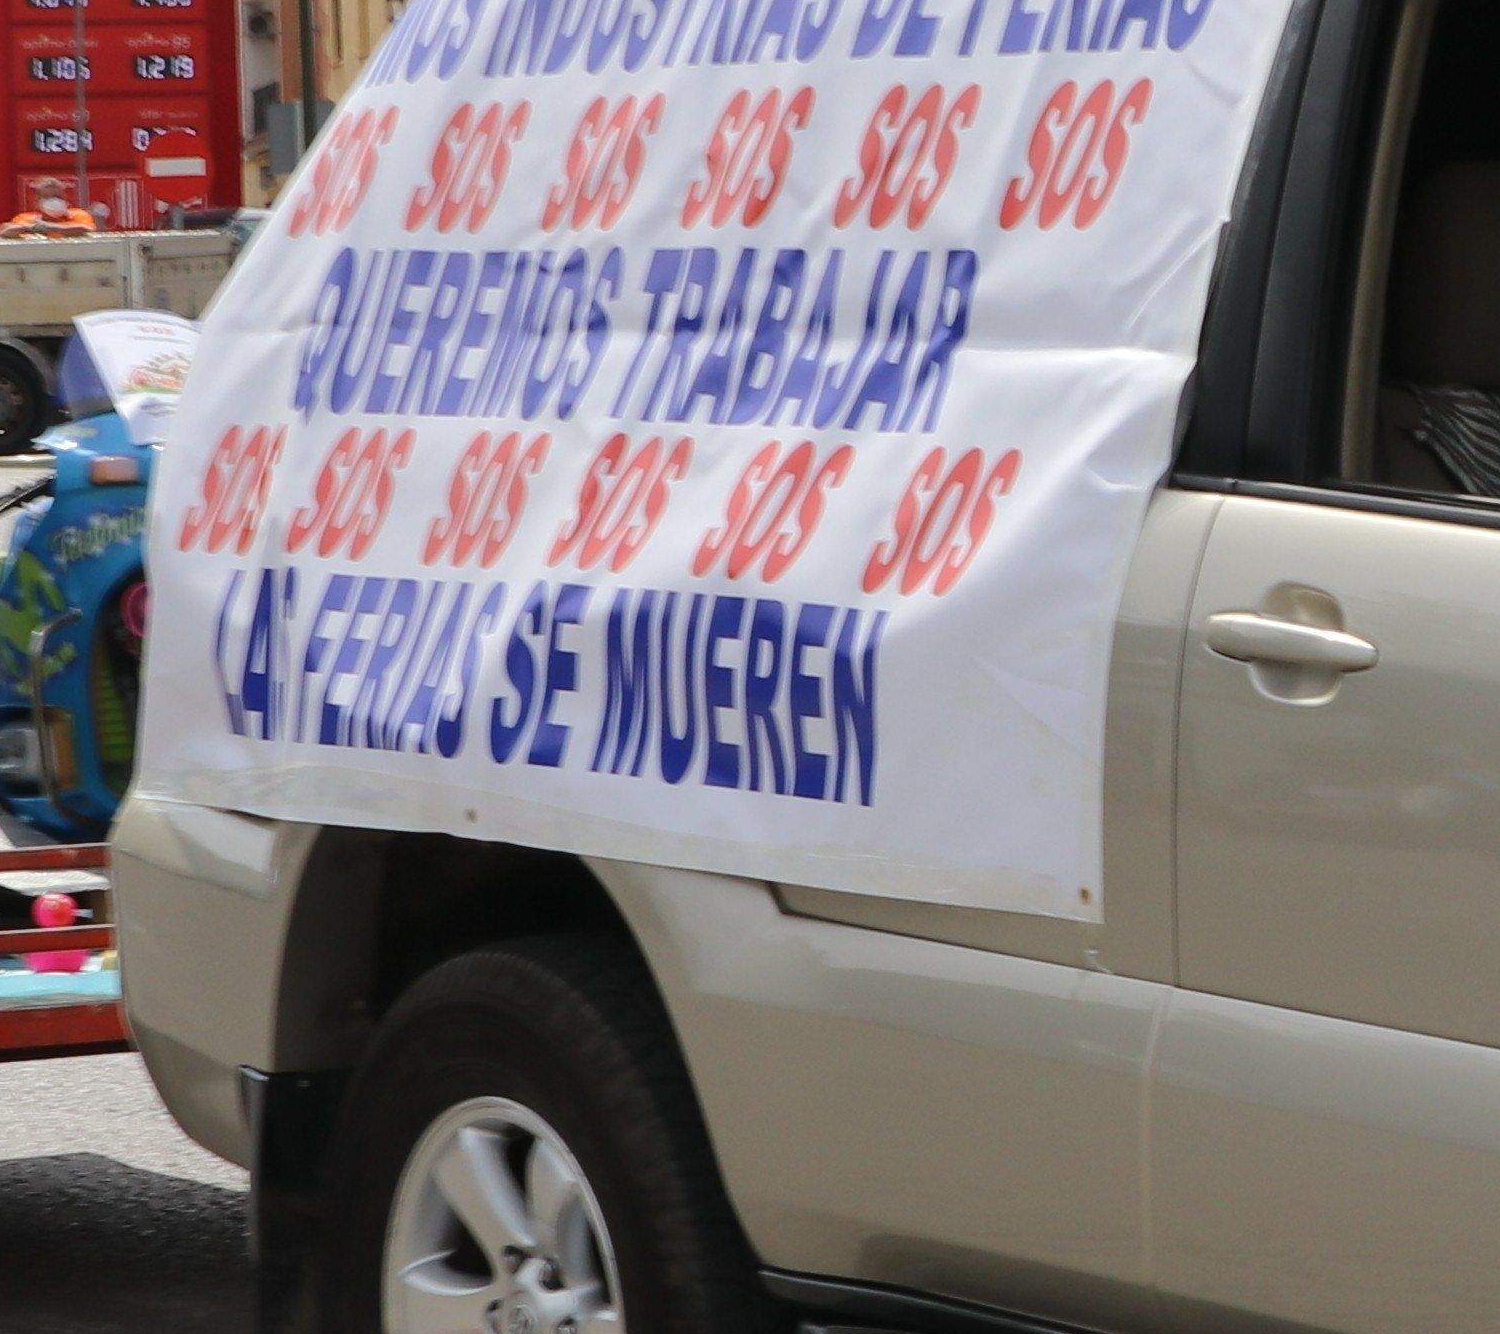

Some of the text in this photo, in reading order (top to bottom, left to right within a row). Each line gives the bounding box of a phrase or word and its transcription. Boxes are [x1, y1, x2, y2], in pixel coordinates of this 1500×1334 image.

[136, 55, 195, 80] 1.219
[288, 76, 1153, 238] SOS SOS SOS SOS SOS SOS
[295, 245, 982, 434] QUEREMOS TRABAJAR
[285, 424, 418, 562] SOS
[420, 428, 553, 569] SOS
[546, 430, 696, 575] SOS
[690, 436, 857, 585] SOS
[861, 445, 1024, 598] SOS
[298, 571, 506, 760] FERIAS
[490, 576, 595, 769] SE
[589, 586, 891, 808] MUEREN
